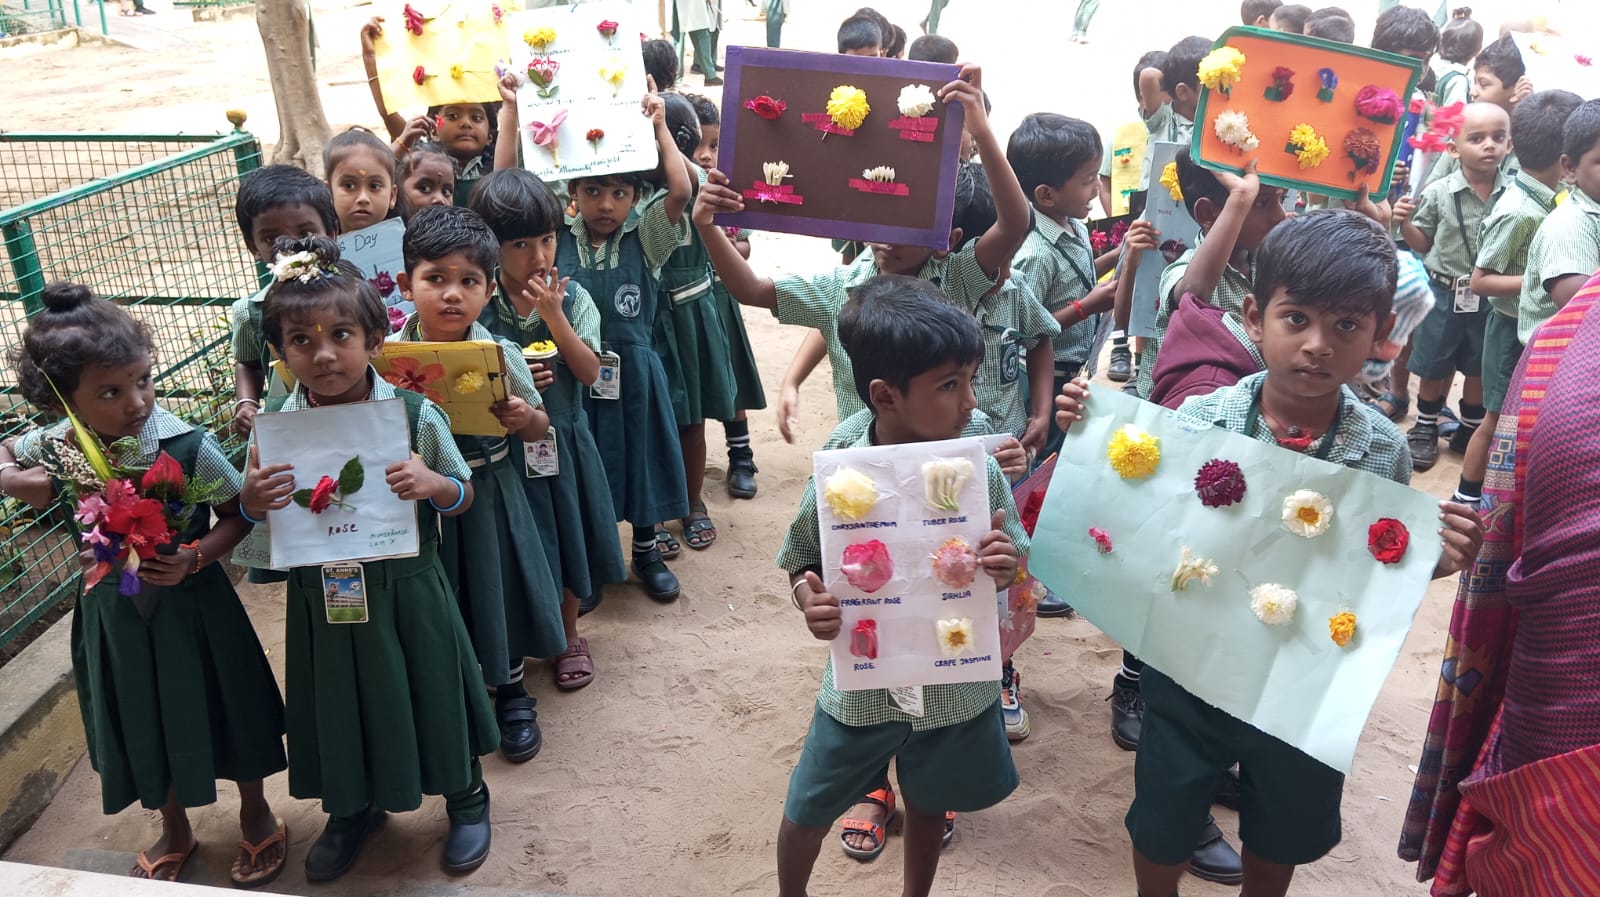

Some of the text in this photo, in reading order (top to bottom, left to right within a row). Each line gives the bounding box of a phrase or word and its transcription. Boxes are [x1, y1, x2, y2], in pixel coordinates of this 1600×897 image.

[353, 233, 378, 252] Day
[922, 516, 968, 526] TUBER ROSE
[884, 596, 902, 605] ROSE
[941, 590, 972, 601] DAHLIA
[934, 655, 992, 668] CRAPE JASMINE
